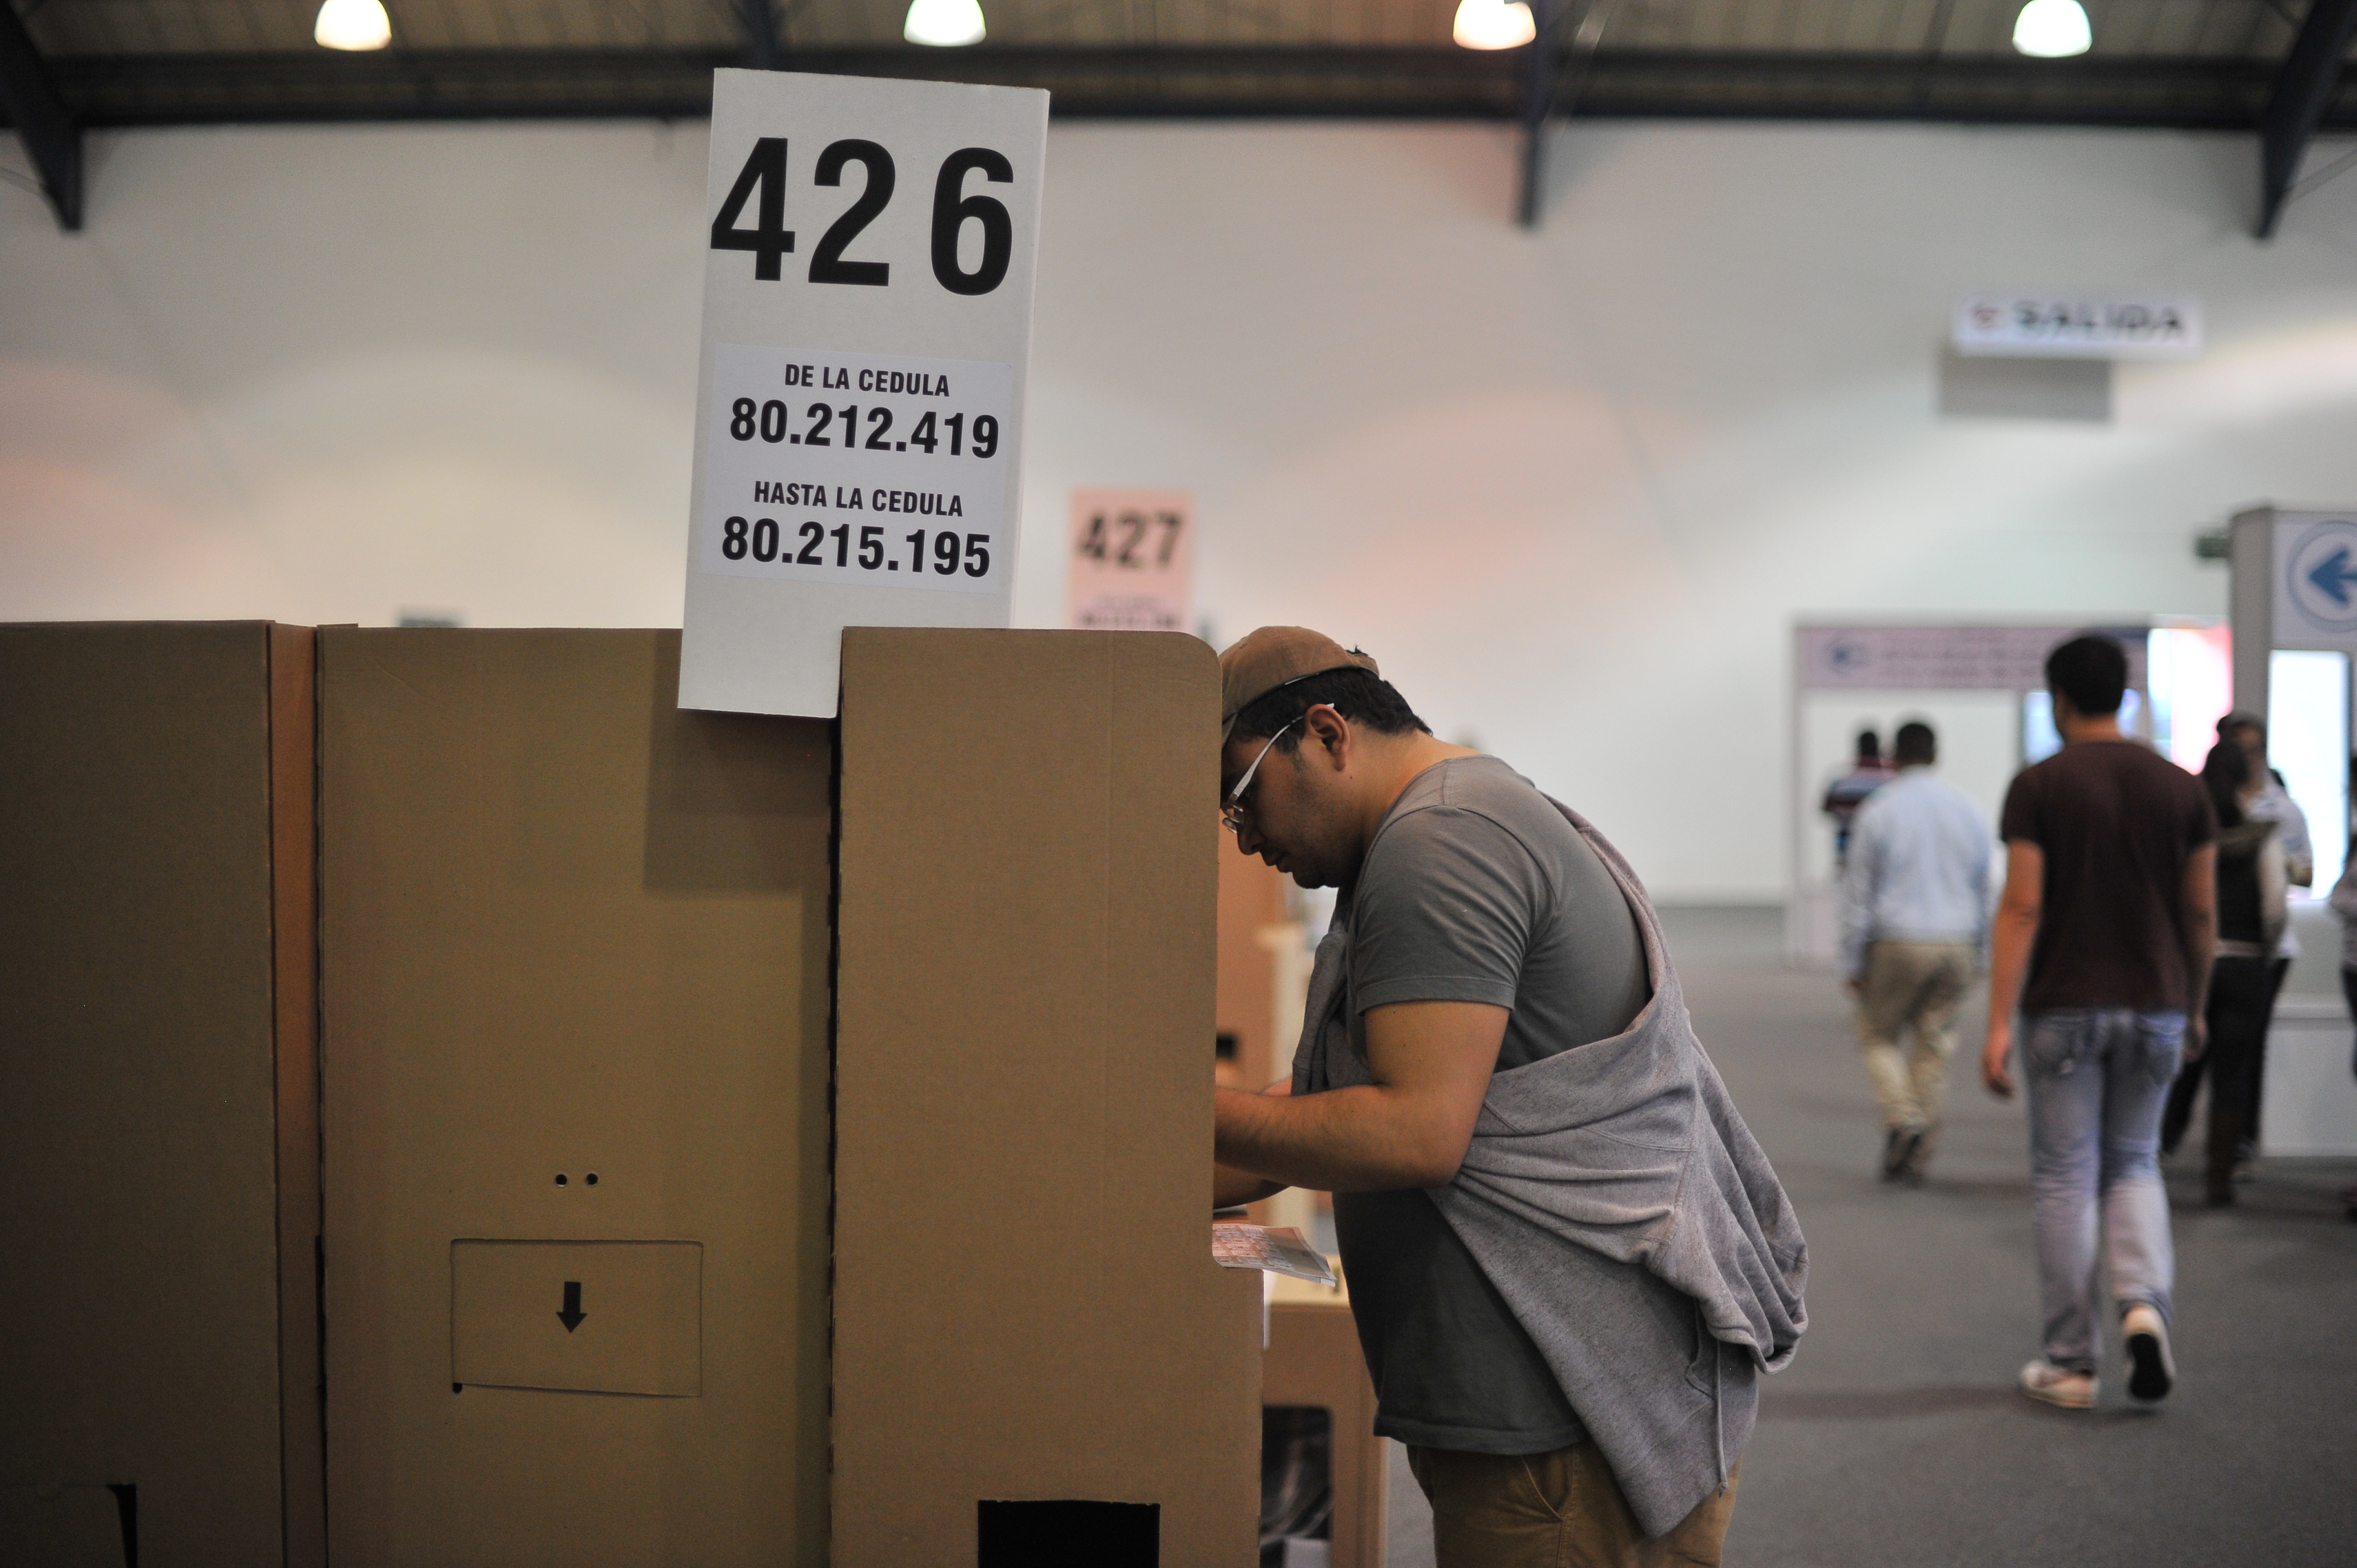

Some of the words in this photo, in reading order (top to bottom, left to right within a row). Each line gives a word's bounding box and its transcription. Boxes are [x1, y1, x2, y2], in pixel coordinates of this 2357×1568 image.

[710, 137, 1014, 296] 426
[785, 364, 815, 387] DE
[823, 367, 850, 390] LA
[858, 369, 950, 397] CEDULA
[730, 397, 999, 458] 80.212.419
[754, 481, 827, 507] HASTA
[836, 487, 863, 510] LA
[872, 489, 963, 517] CEDULA
[722, 516, 990, 577] 80.215.195
[1078, 510, 1184, 568] 427
